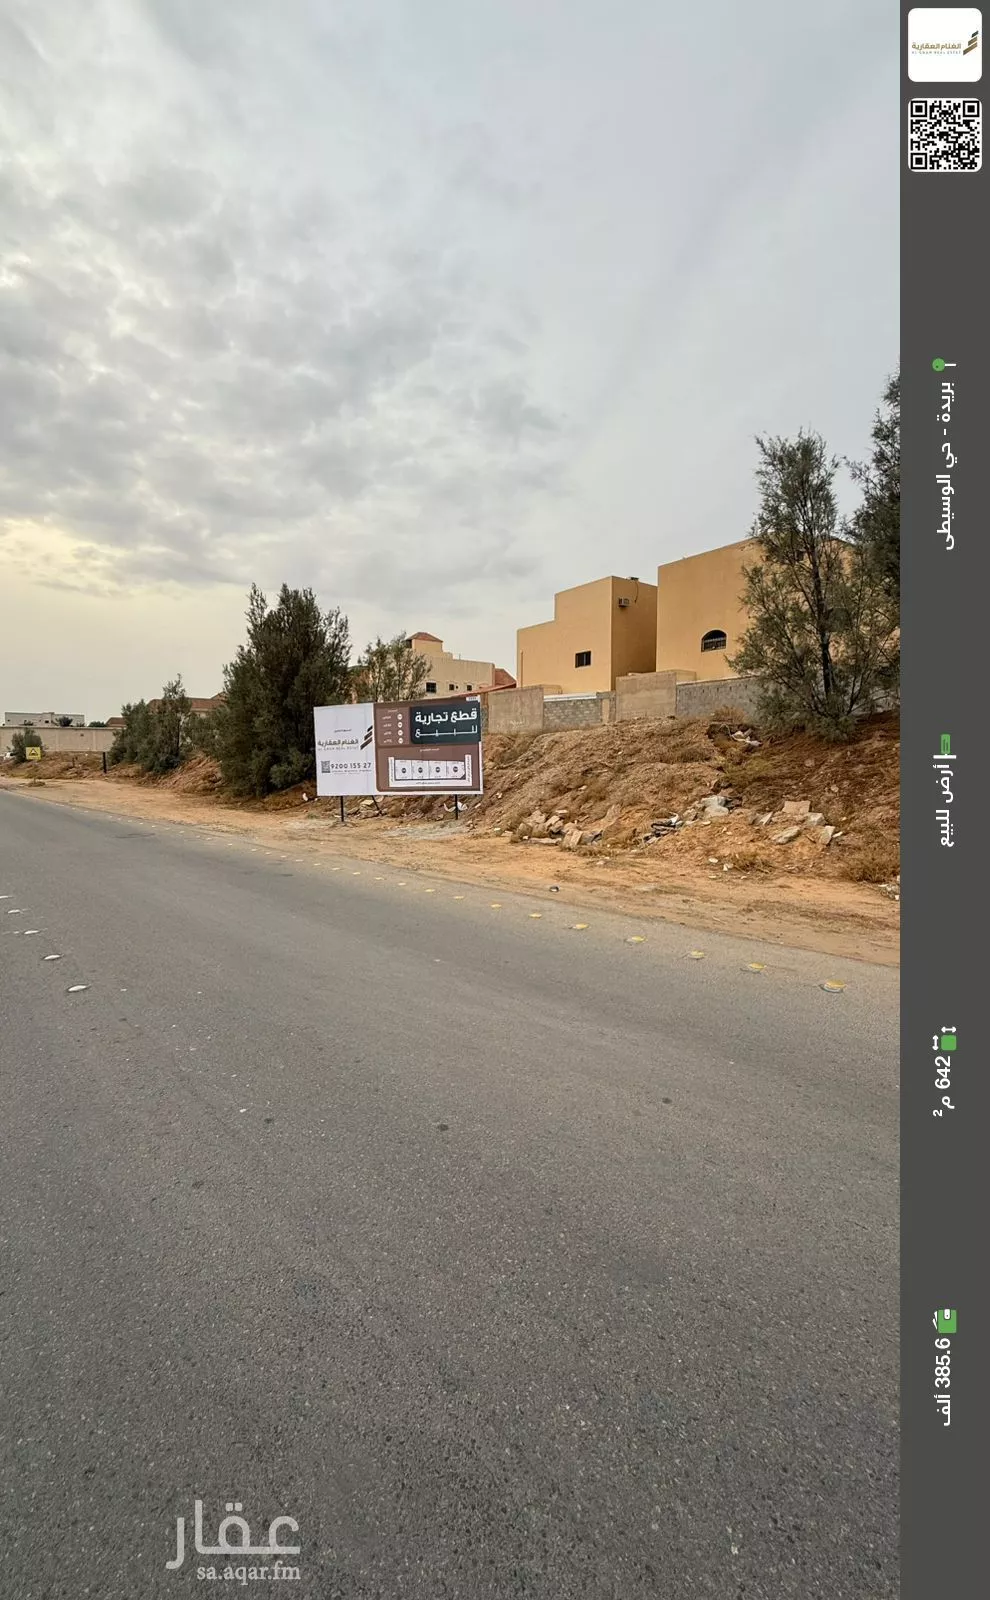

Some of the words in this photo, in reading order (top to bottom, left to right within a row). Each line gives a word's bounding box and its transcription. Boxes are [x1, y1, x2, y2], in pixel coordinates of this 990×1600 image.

[415, 711, 449, 726] تجارية
[450, 707, 478, 724] قطع
[415, 725, 478, 738] للبيع
